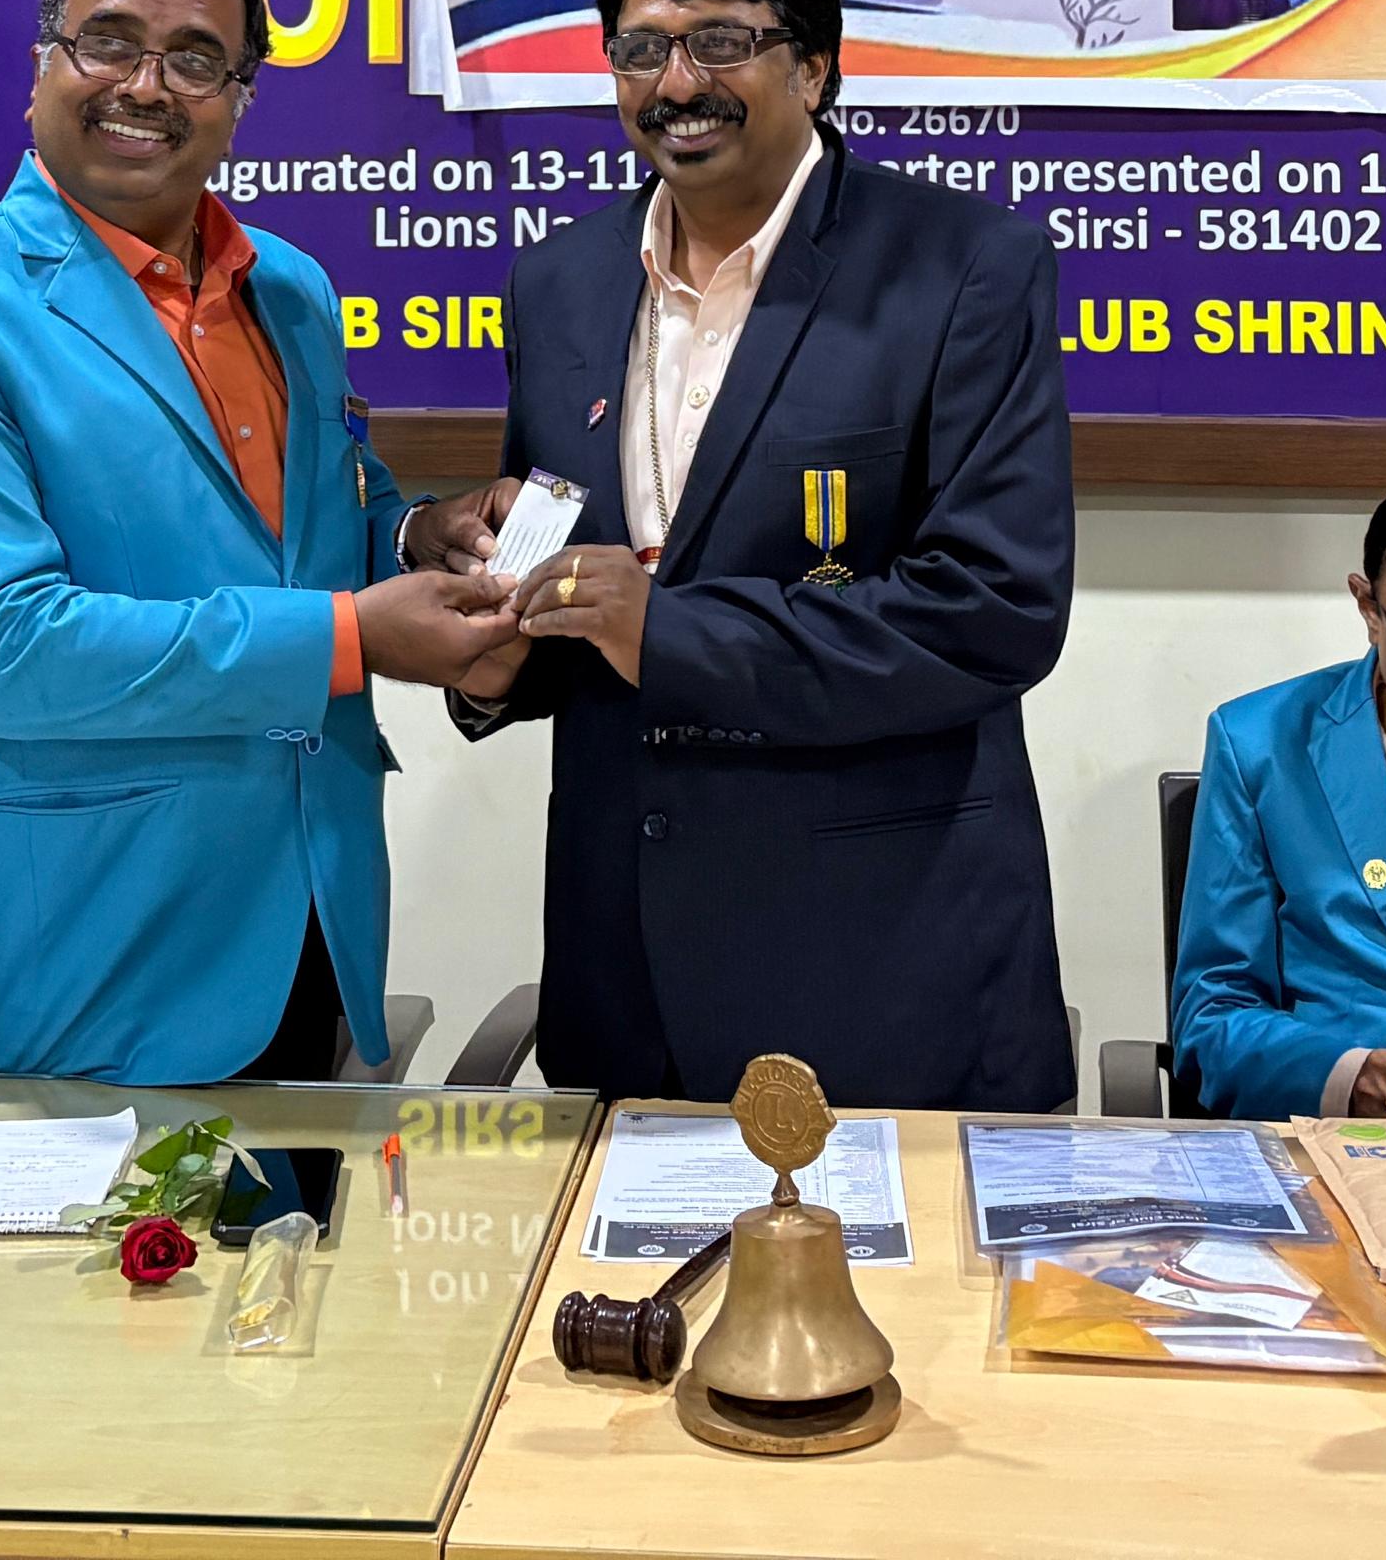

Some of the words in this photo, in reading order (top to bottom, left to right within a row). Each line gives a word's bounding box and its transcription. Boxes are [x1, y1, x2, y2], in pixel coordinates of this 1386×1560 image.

[900, 106, 1020, 137] 26670
[434, 161, 493, 192] on
[1013, 150, 1261, 203] presented
[1278, 160, 1342, 194] on
[375, 207, 498, 248] Lions
[1048, 207, 1148, 251] Sirsi
[1198, 209, 1383, 252] 581402
